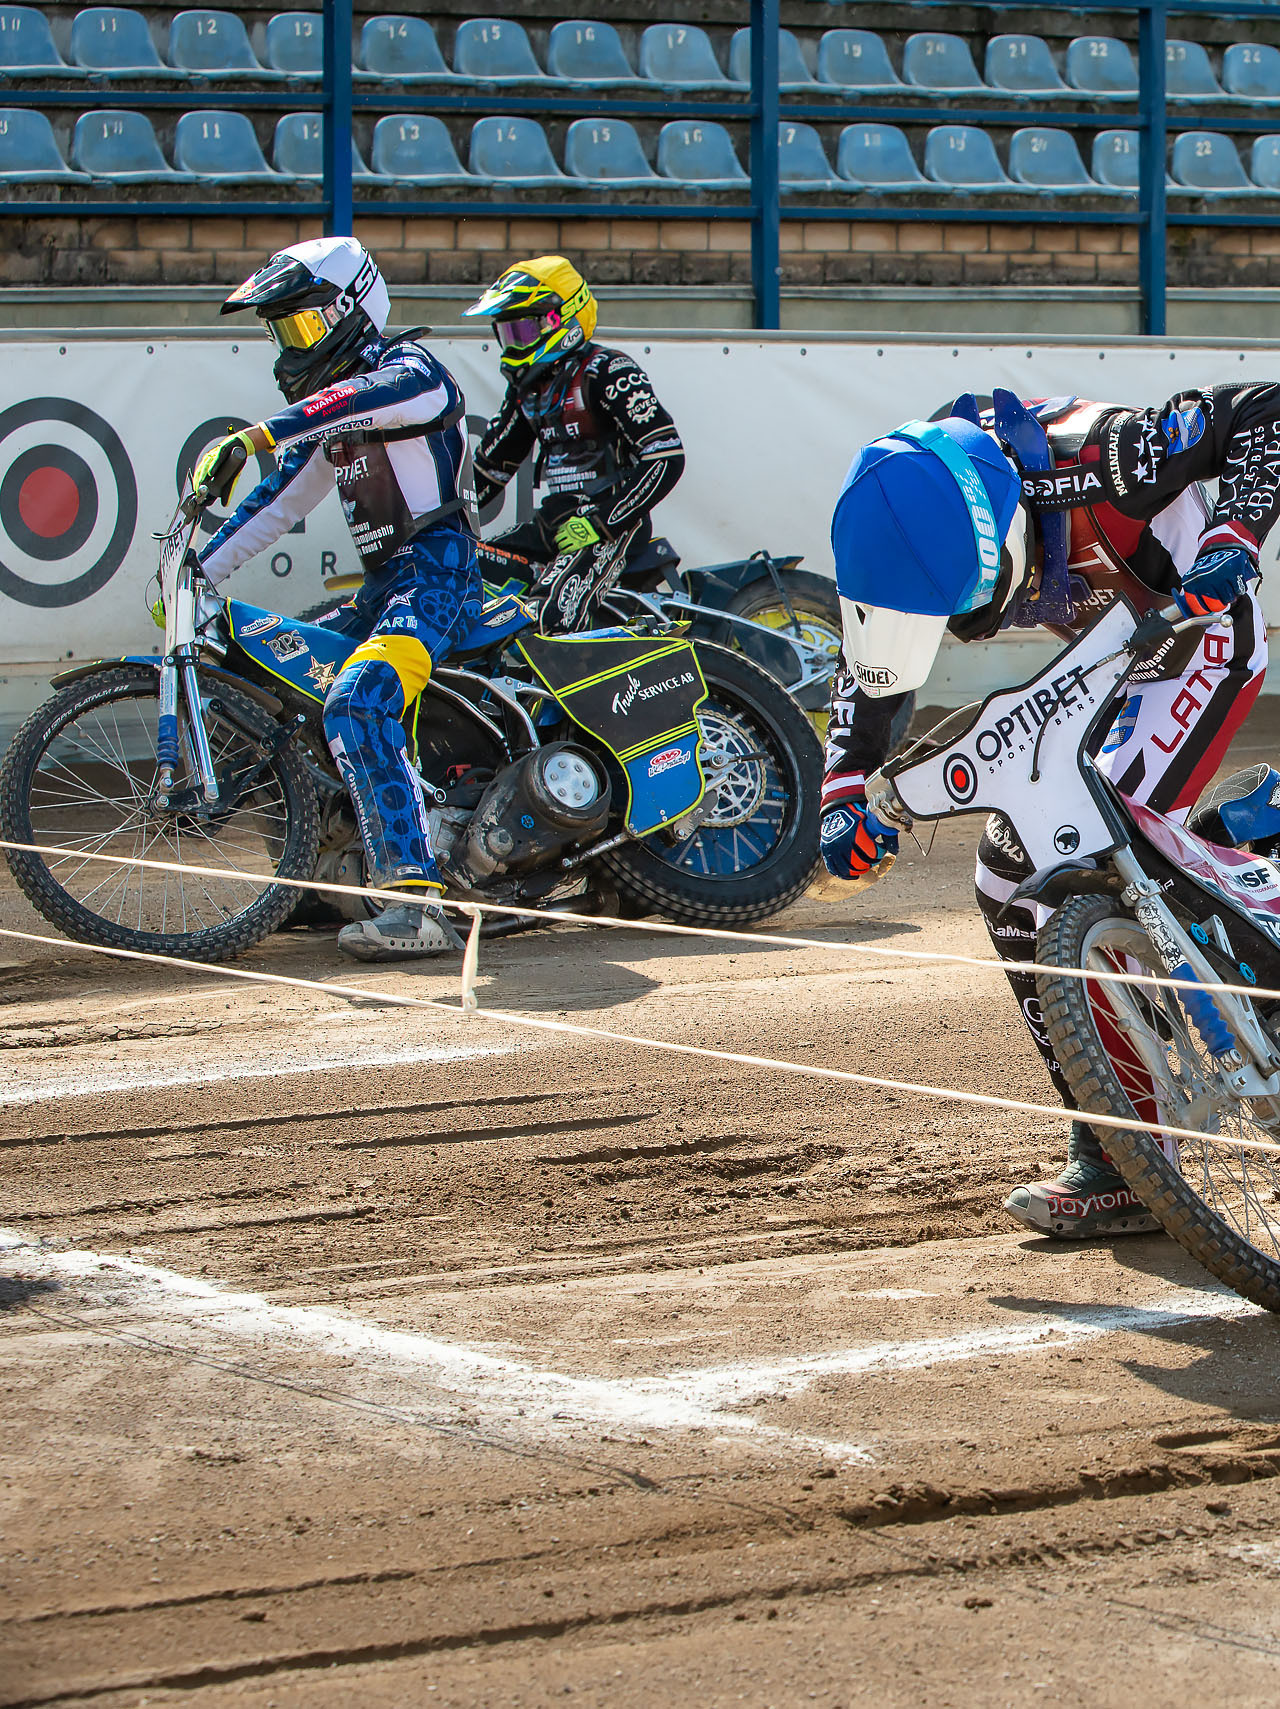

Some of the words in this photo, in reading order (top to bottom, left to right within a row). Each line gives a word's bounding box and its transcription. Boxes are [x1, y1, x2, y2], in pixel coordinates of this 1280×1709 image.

[101, 18, 116, 32] 11
[197, 19, 217, 34] 12
[295, 22, 312, 36] 13
[482, 26, 500, 42] 15
[667, 30, 686, 48] 17
[1089, 42, 1108, 56] 22
[203, 122, 220, 139] 11
[400, 126, 419, 141] 13
[497, 127, 516, 142] 14
[592, 128, 611, 143] 15
[684, 129, 702, 145] 16
[1196, 140, 1212, 156] 22
[306, 388, 355, 414] KVANTUM
[322, 401, 348, 417] Avesta
[1023, 472, 1102, 497] SOFIA
[267, 629, 306, 656] RPS
[856, 665, 889, 684] SHOEI
[638, 677, 680, 701] SERVICE
[681, 671, 695, 685] AB
[611, 674, 641, 716] Truck
[976, 665, 1090, 761] OPTIBET
[989, 734, 1045, 774] SPORT
[1054, 697, 1095, 726] BĀRS
